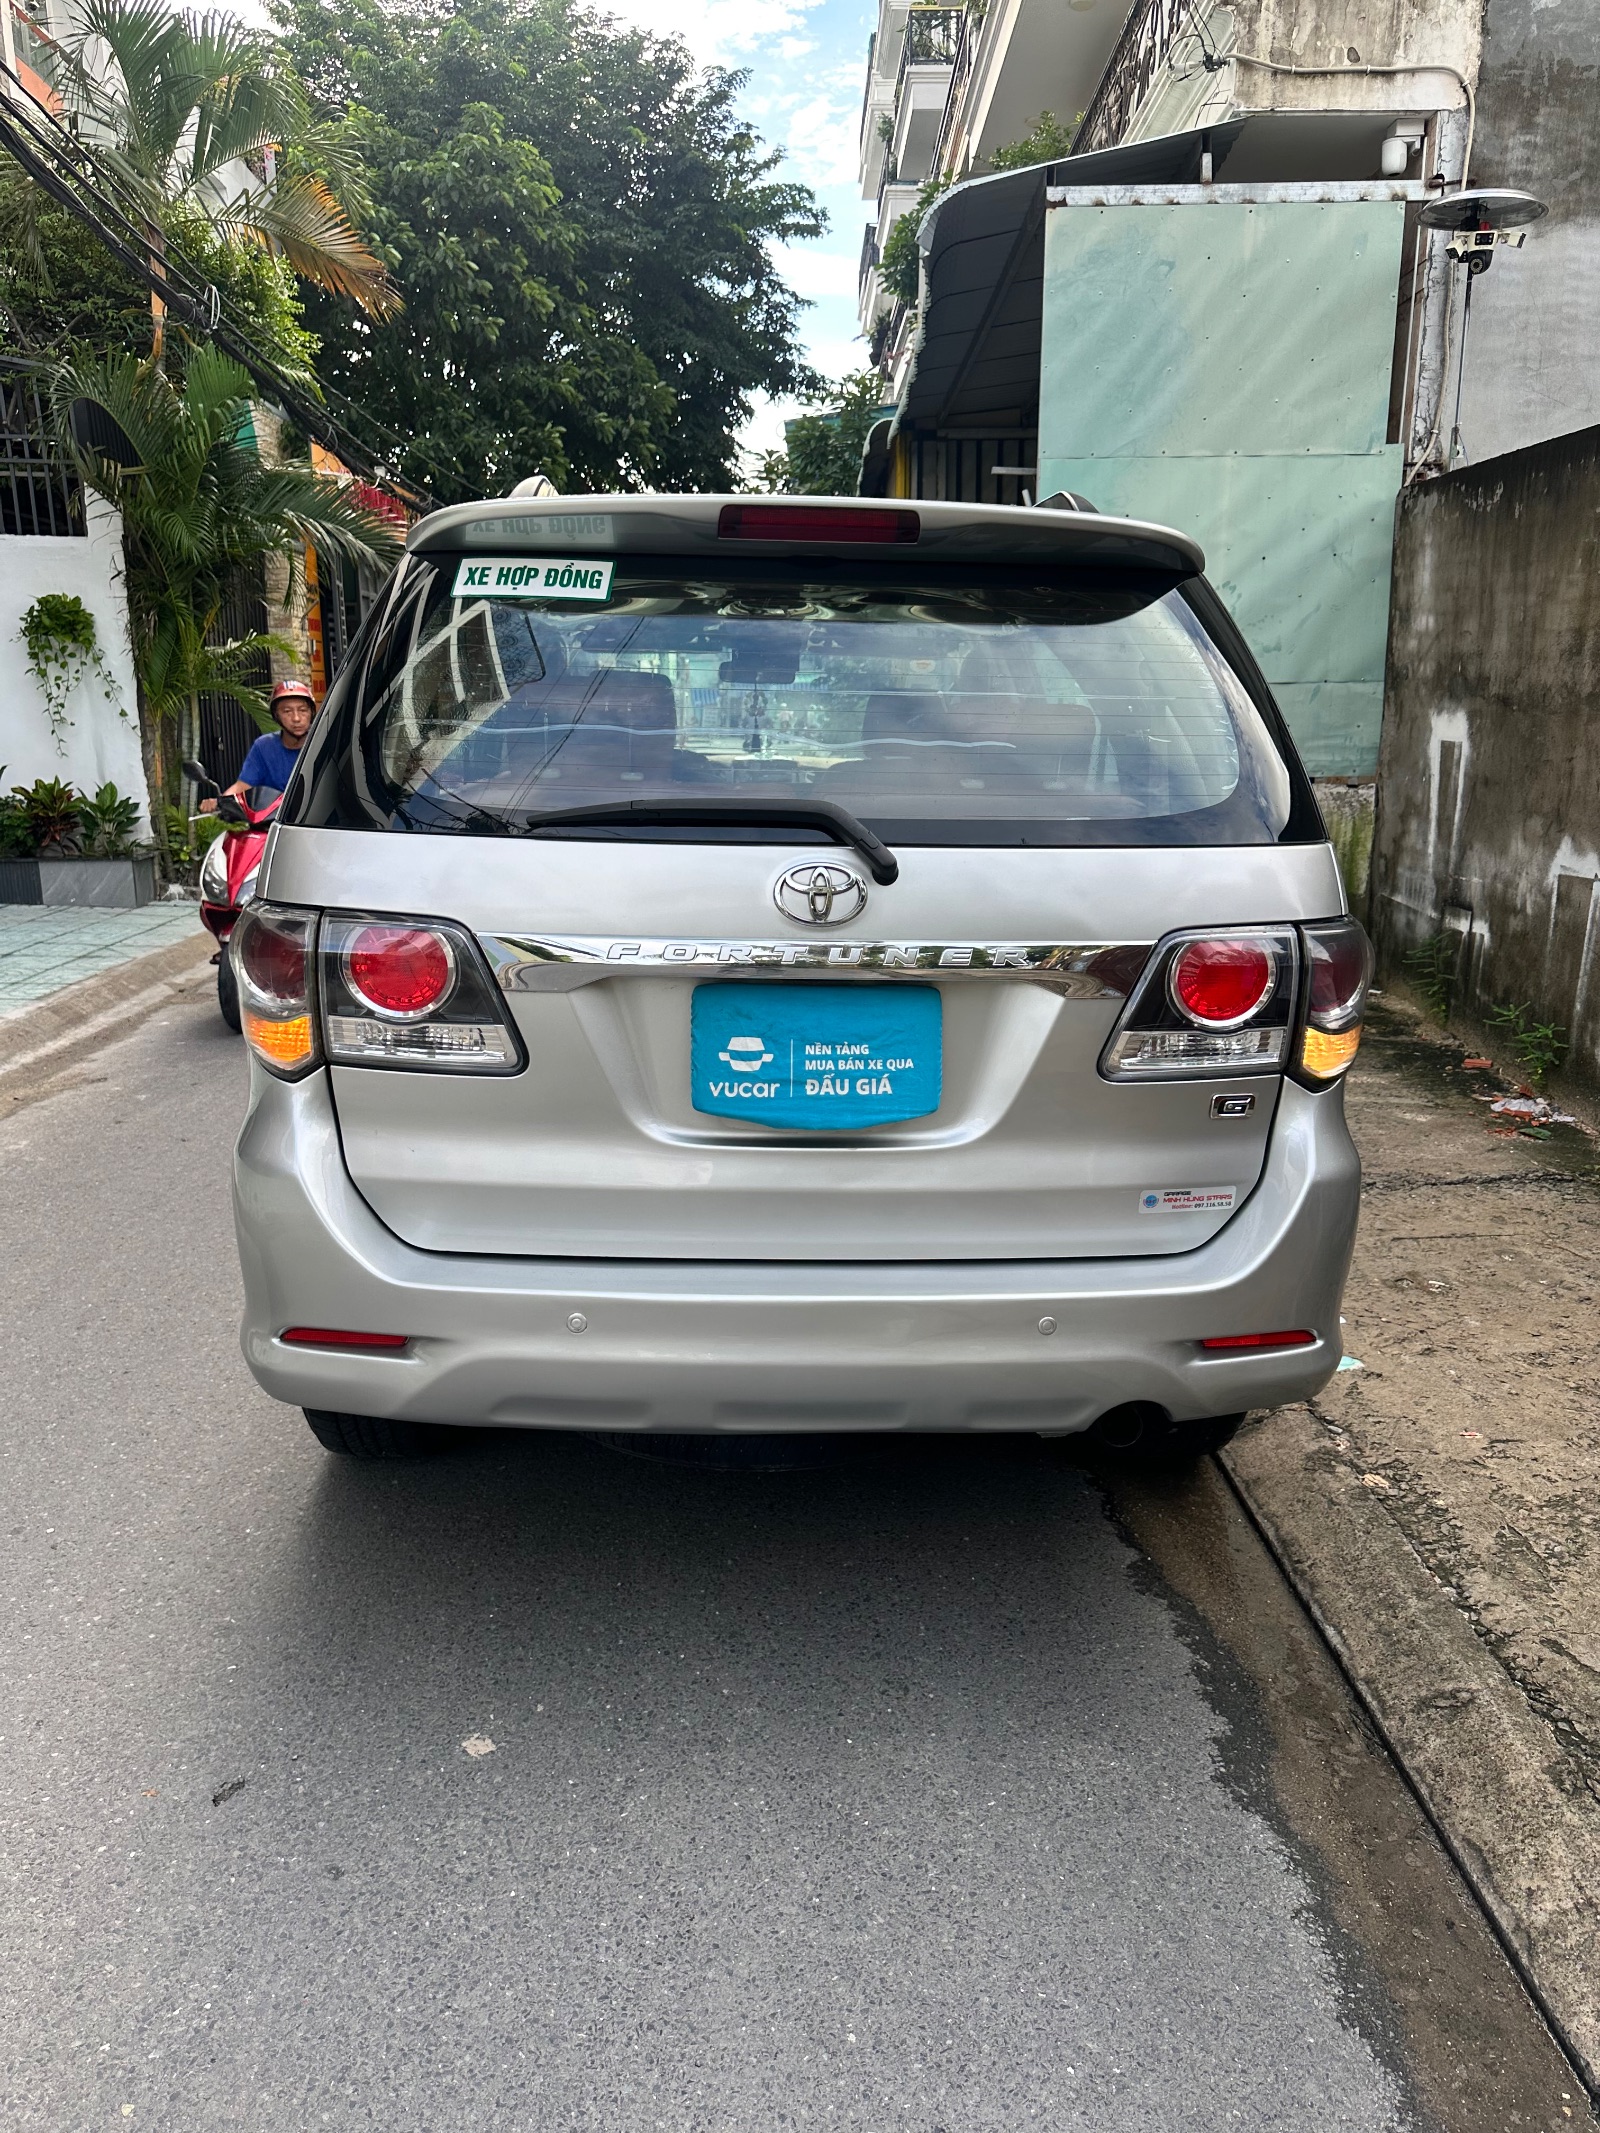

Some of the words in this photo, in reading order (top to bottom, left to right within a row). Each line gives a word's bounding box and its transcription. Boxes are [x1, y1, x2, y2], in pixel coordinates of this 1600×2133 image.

[463, 566, 492, 586] XE
[496, 565, 539, 590] HỢP
[544, 562, 604, 590] ĐỒNG
[607, 942, 1028, 966] FORTUNER
[805, 1041, 832, 1055] NỀN
[835, 1041, 869, 1055] TẢNG
[805, 1060, 834, 1071] MUA
[838, 1058, 865, 1070] BÁN
[868, 1060, 883, 1070] XE
[886, 1058, 914, 1071] QUA
[709, 1081, 780, 1098] vucar
[805, 1074, 850, 1095] ĐẤU
[856, 1073, 893, 1095] GIÁ
